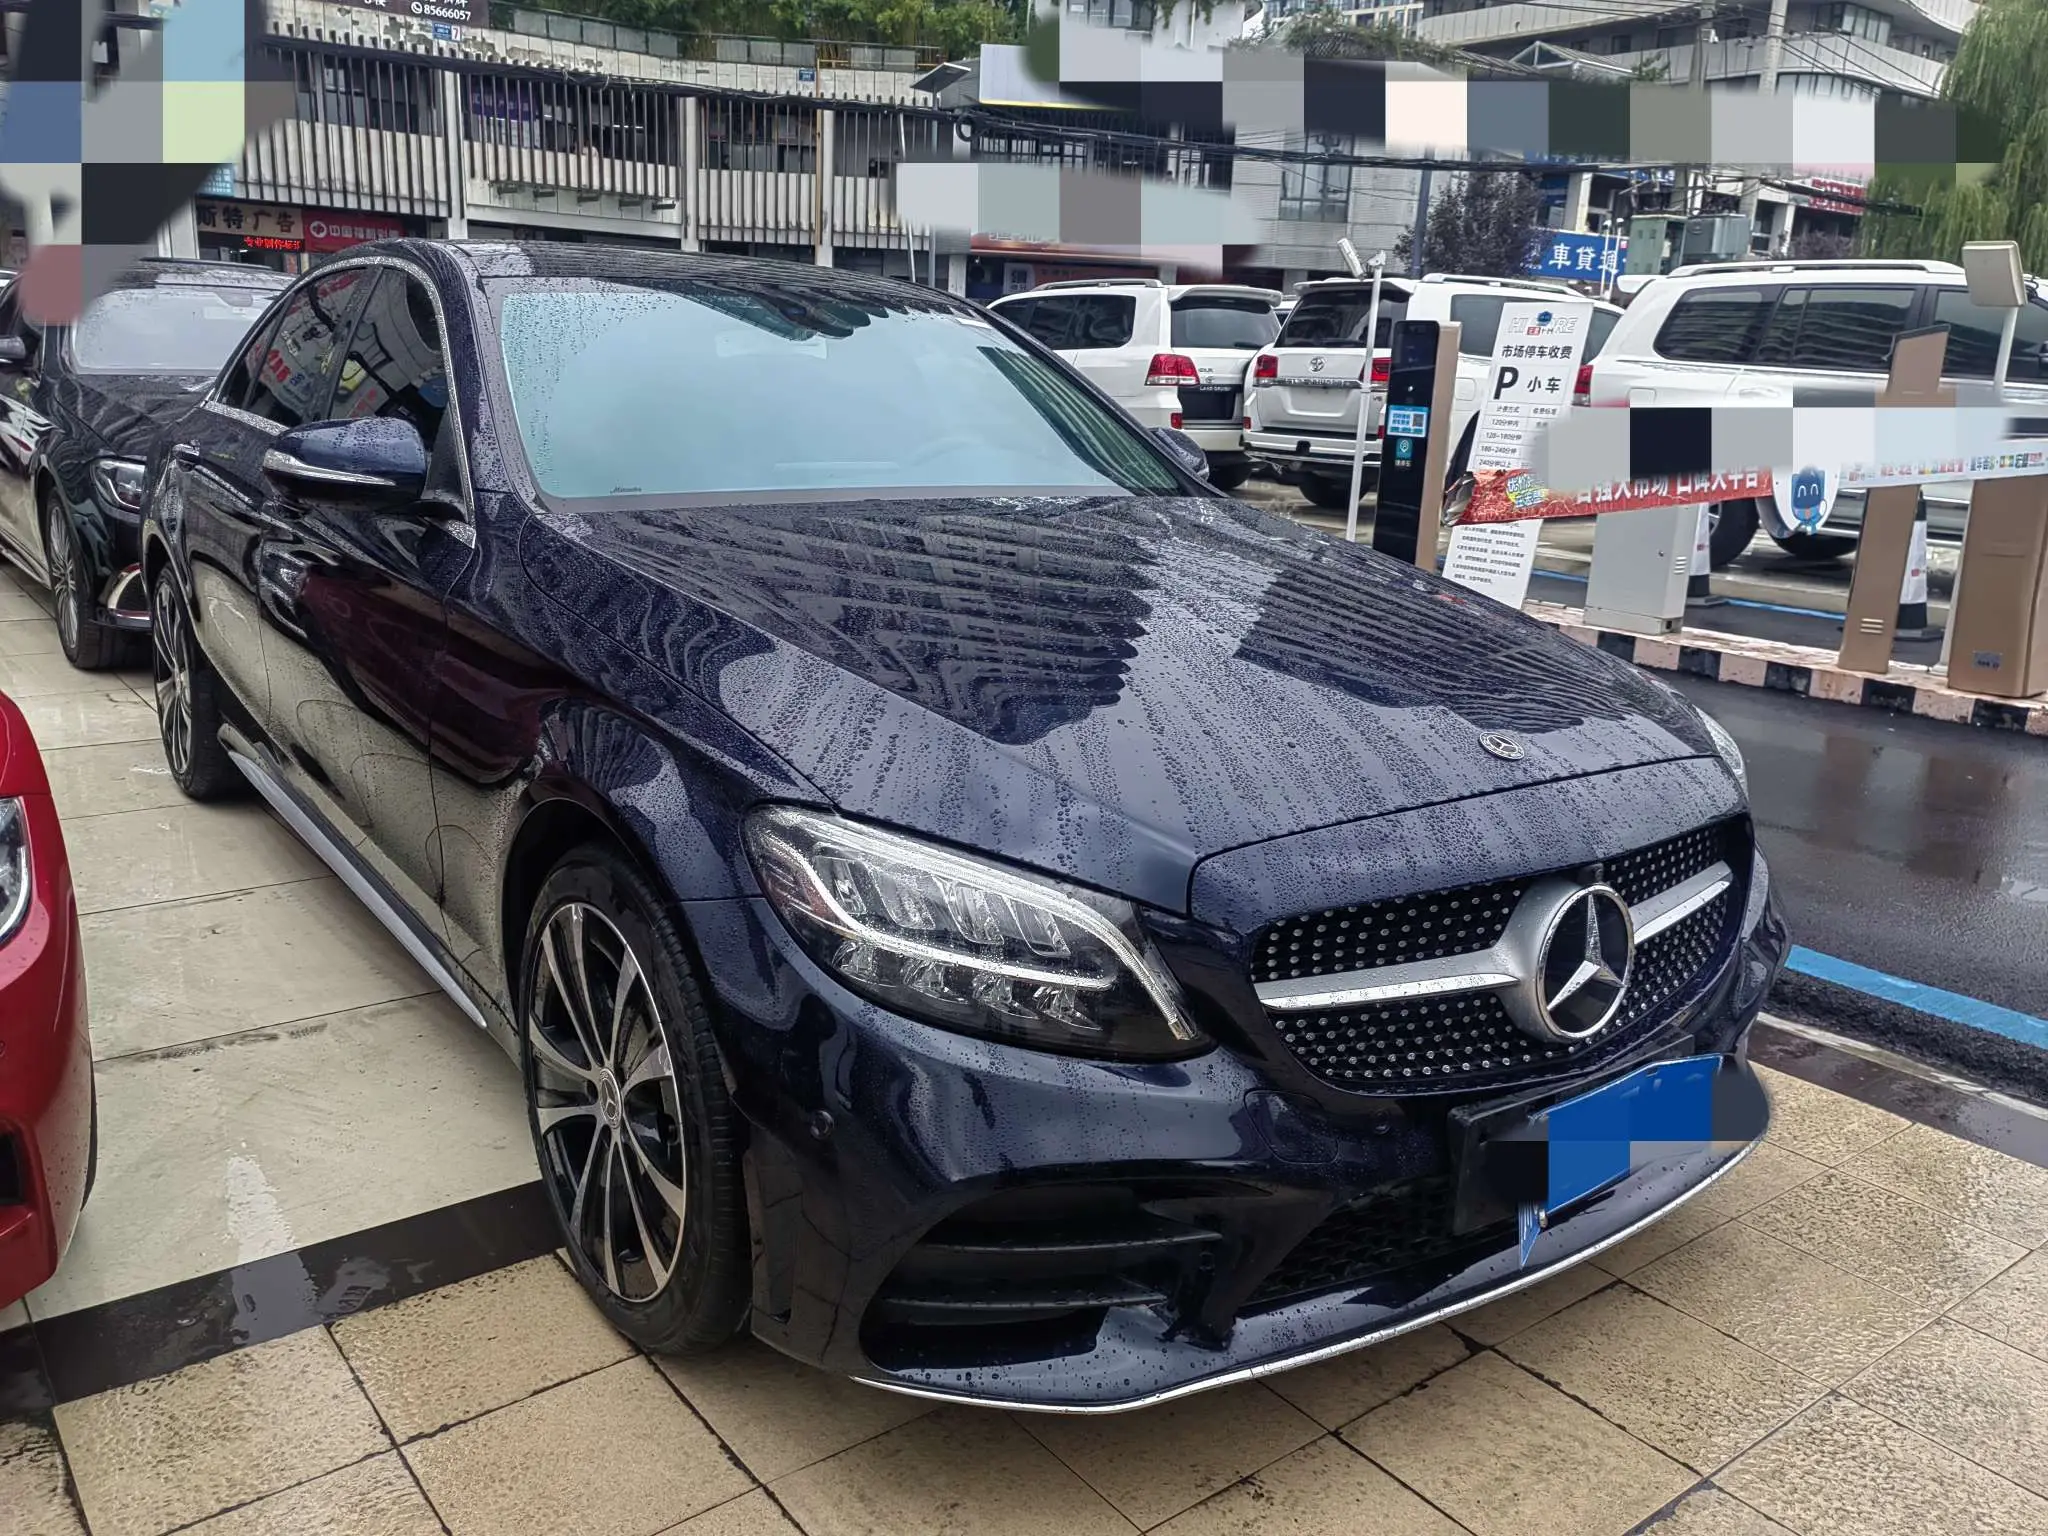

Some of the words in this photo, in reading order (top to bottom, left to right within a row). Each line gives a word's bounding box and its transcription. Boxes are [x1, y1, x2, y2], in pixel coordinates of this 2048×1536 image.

[423, 5, 471, 21] 85666057
[1501, 344, 1573, 360] 市场停车收费
[1493, 365, 1519, 400] P
[1527, 376, 1562, 393] 小车
